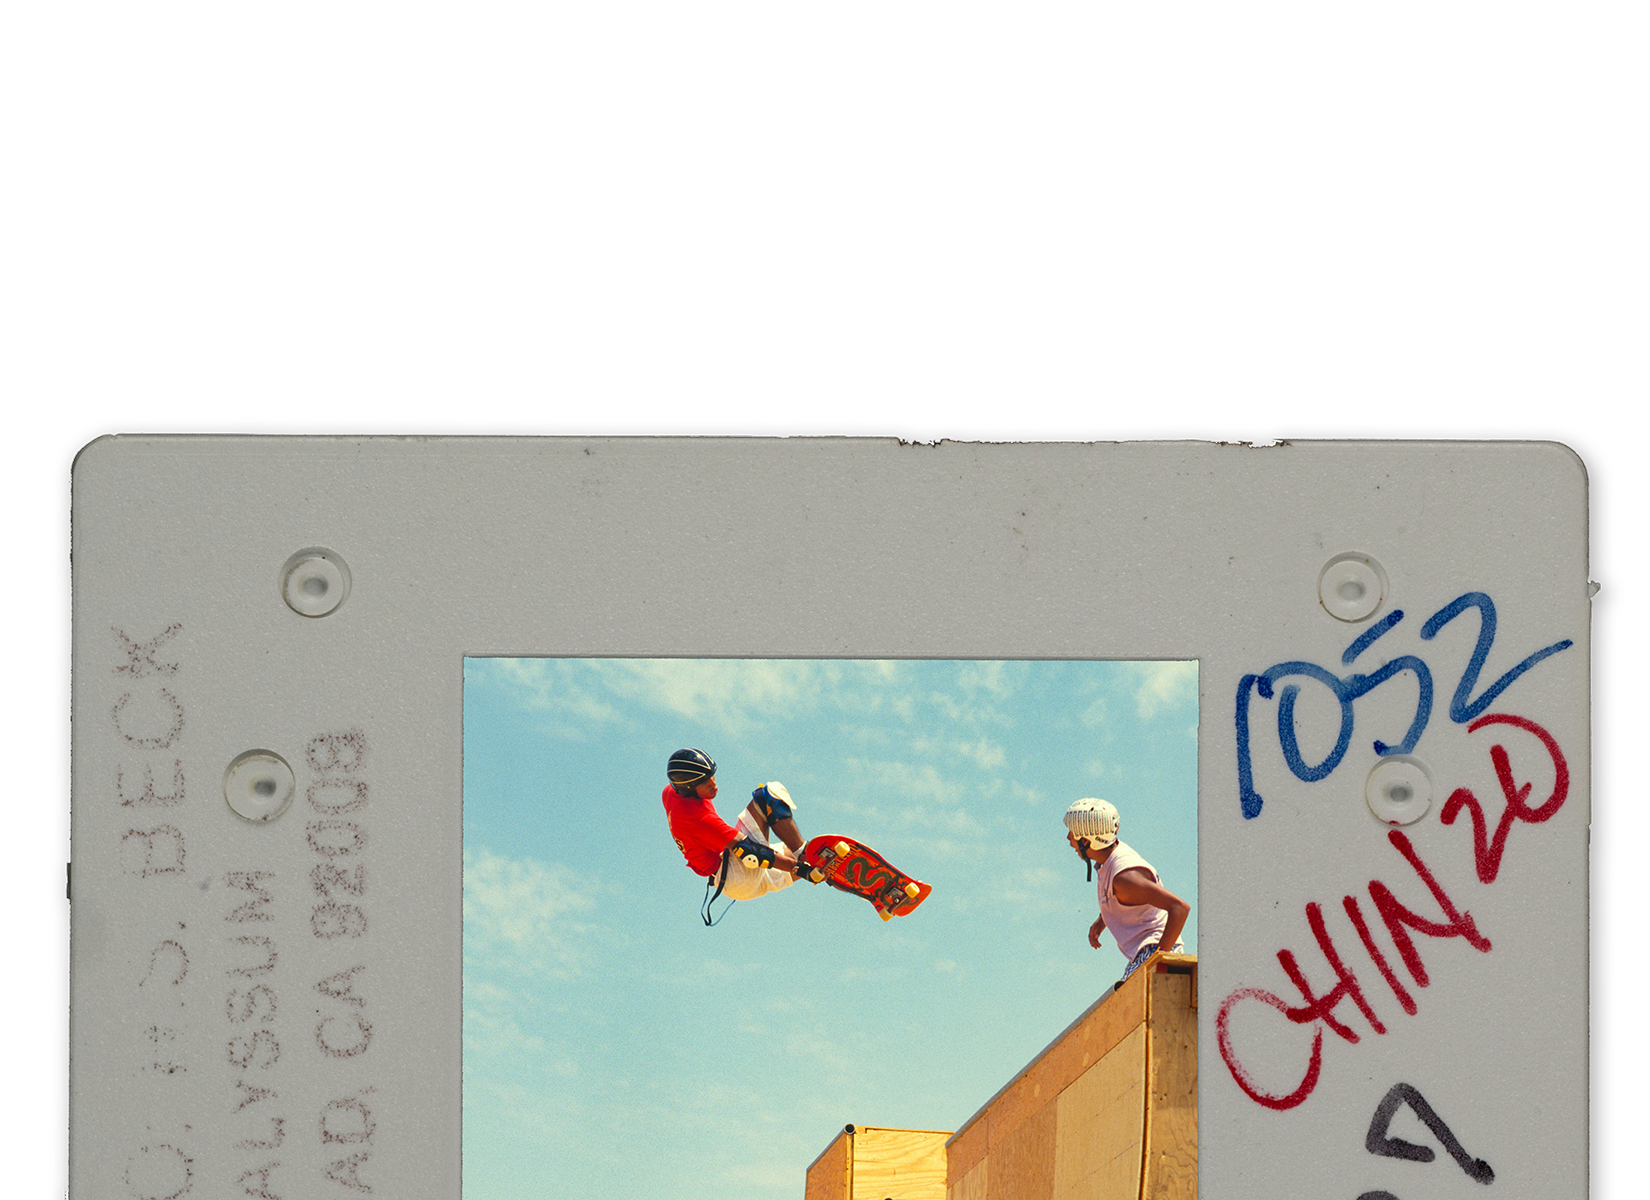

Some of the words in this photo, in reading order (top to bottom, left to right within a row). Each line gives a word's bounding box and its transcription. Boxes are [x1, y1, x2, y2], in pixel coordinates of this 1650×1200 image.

[110, 621, 187, 878] BECK
[1234, 591, 1573, 819] 1052
[313, 964, 374, 1059] CA
[1215, 828, 1492, 1111] CHIN
